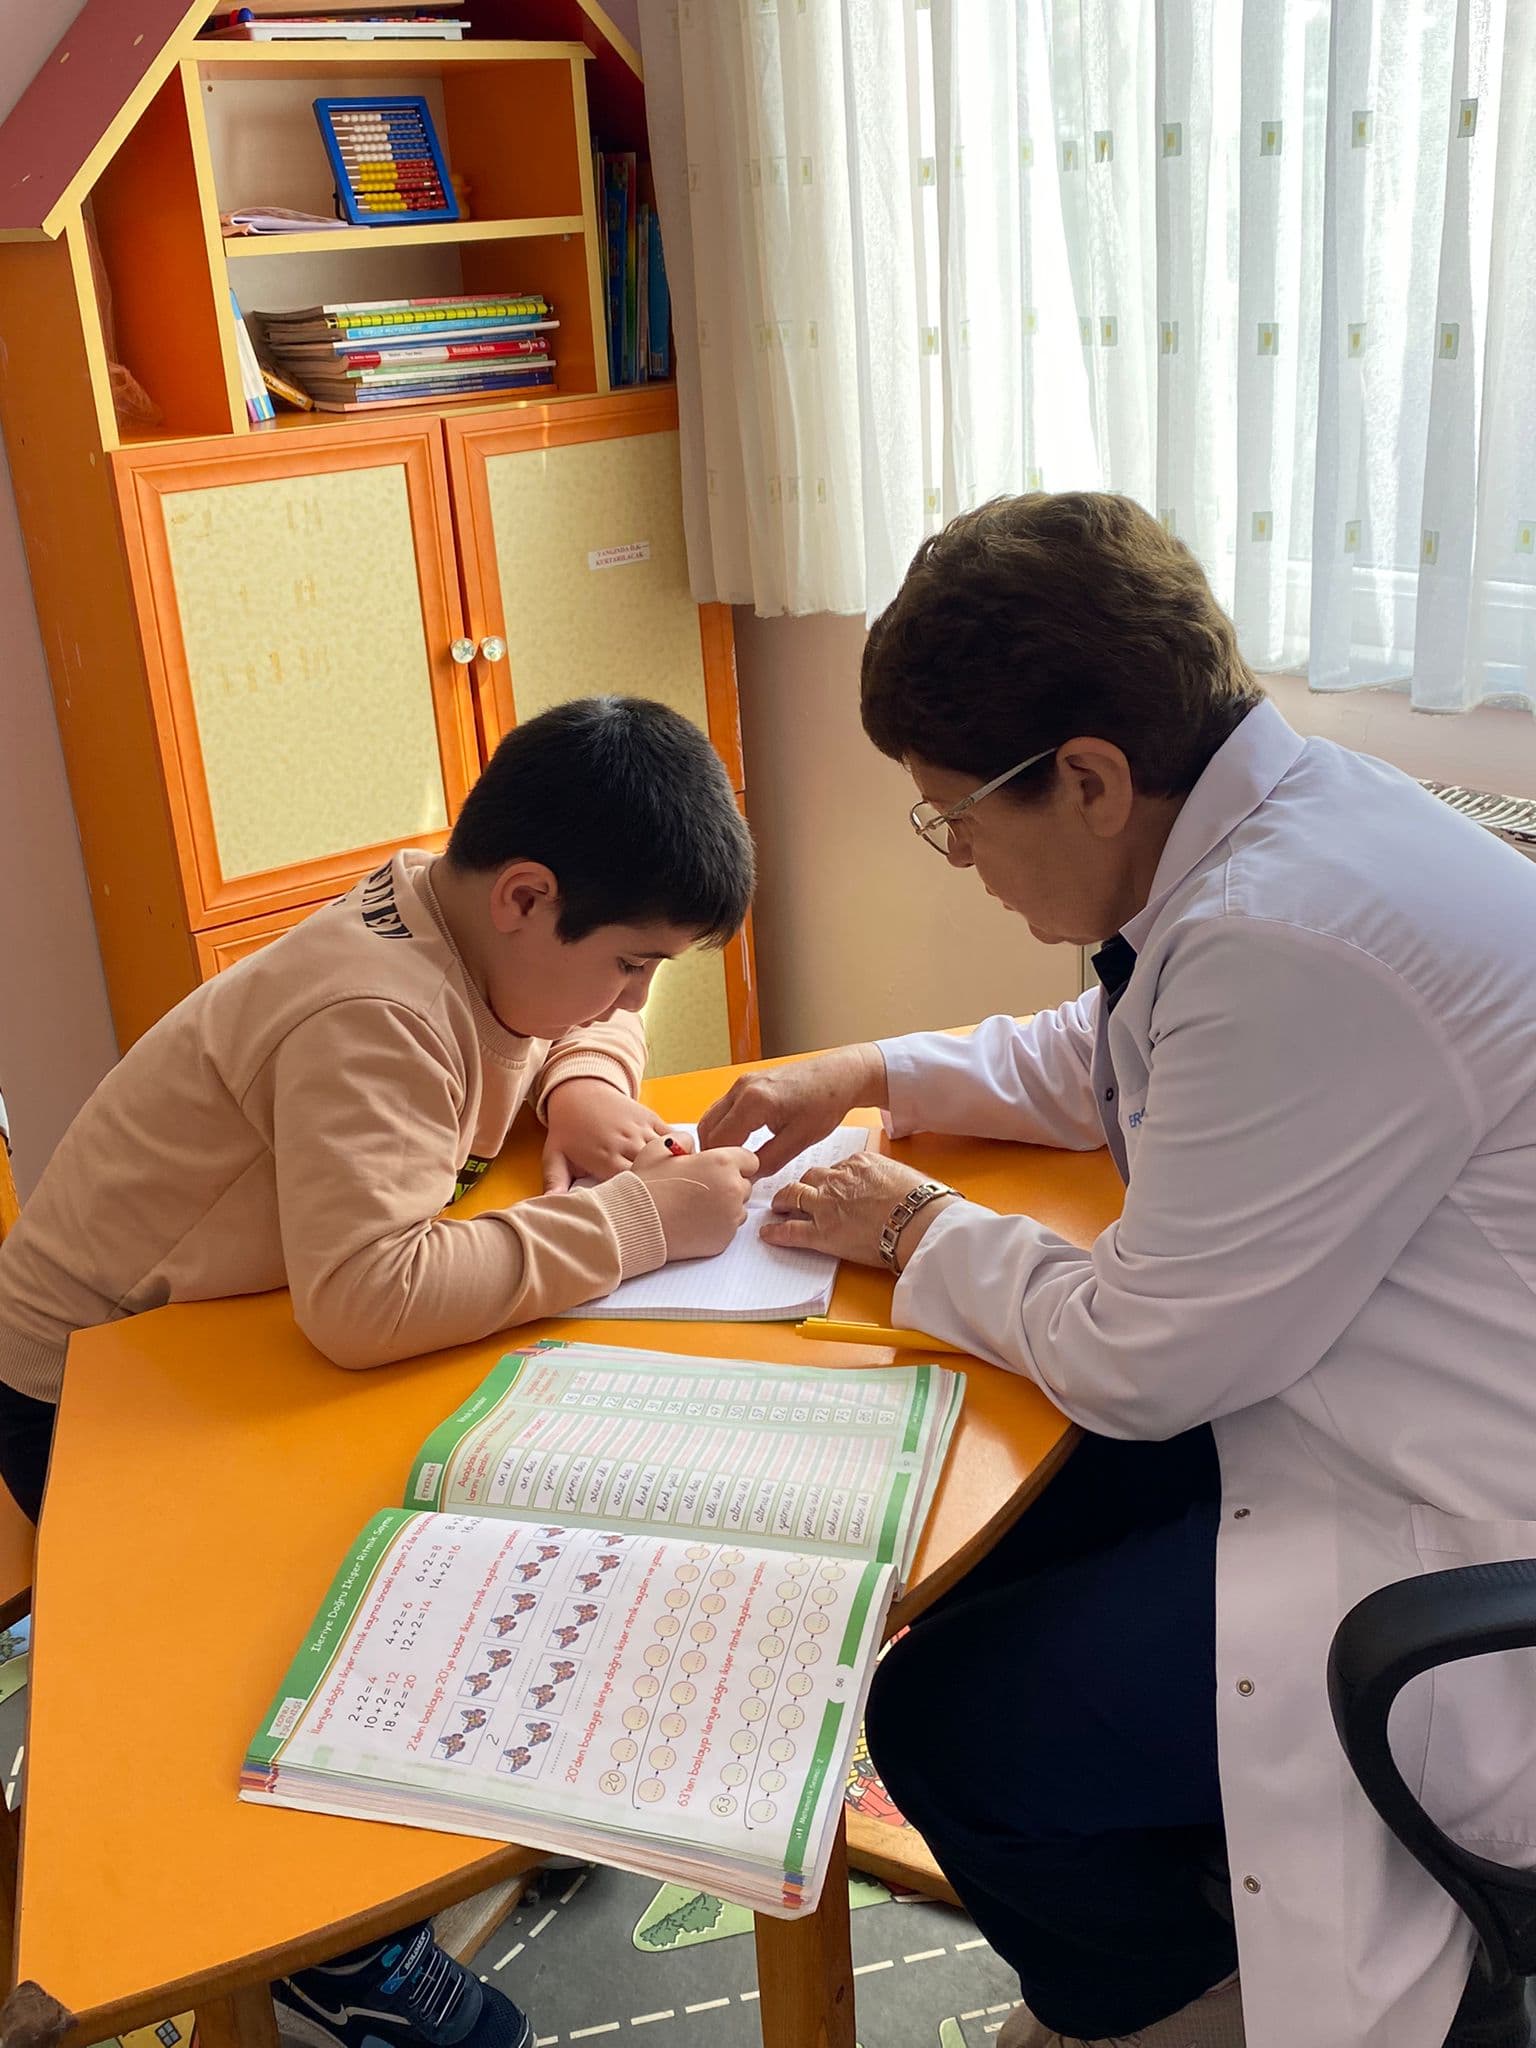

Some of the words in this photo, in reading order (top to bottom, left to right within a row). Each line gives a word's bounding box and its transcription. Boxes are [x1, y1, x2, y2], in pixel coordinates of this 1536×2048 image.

[428, 1577, 443, 1589] 14
[447, 1544, 462, 1554] 16
[327, 1591, 348, 1618] Doğru
[399, 1638, 414, 1650] 12
[418, 1600, 433, 1611] 14
[346, 1713, 360, 1721] 2
[356, 1694, 369, 1702] 2
[365, 1675, 378, 1684] 4
[362, 1715, 379, 1729] 10
[384, 1671, 400, 1684] 12
[381, 1719, 397, 1732] 18
[393, 1700, 406, 1708] 2
[402, 1674, 419, 1688] 20
[834, 1677, 845, 1687] 56
[603, 1773, 622, 1790] 20
[714, 1796, 732, 1812] 63
